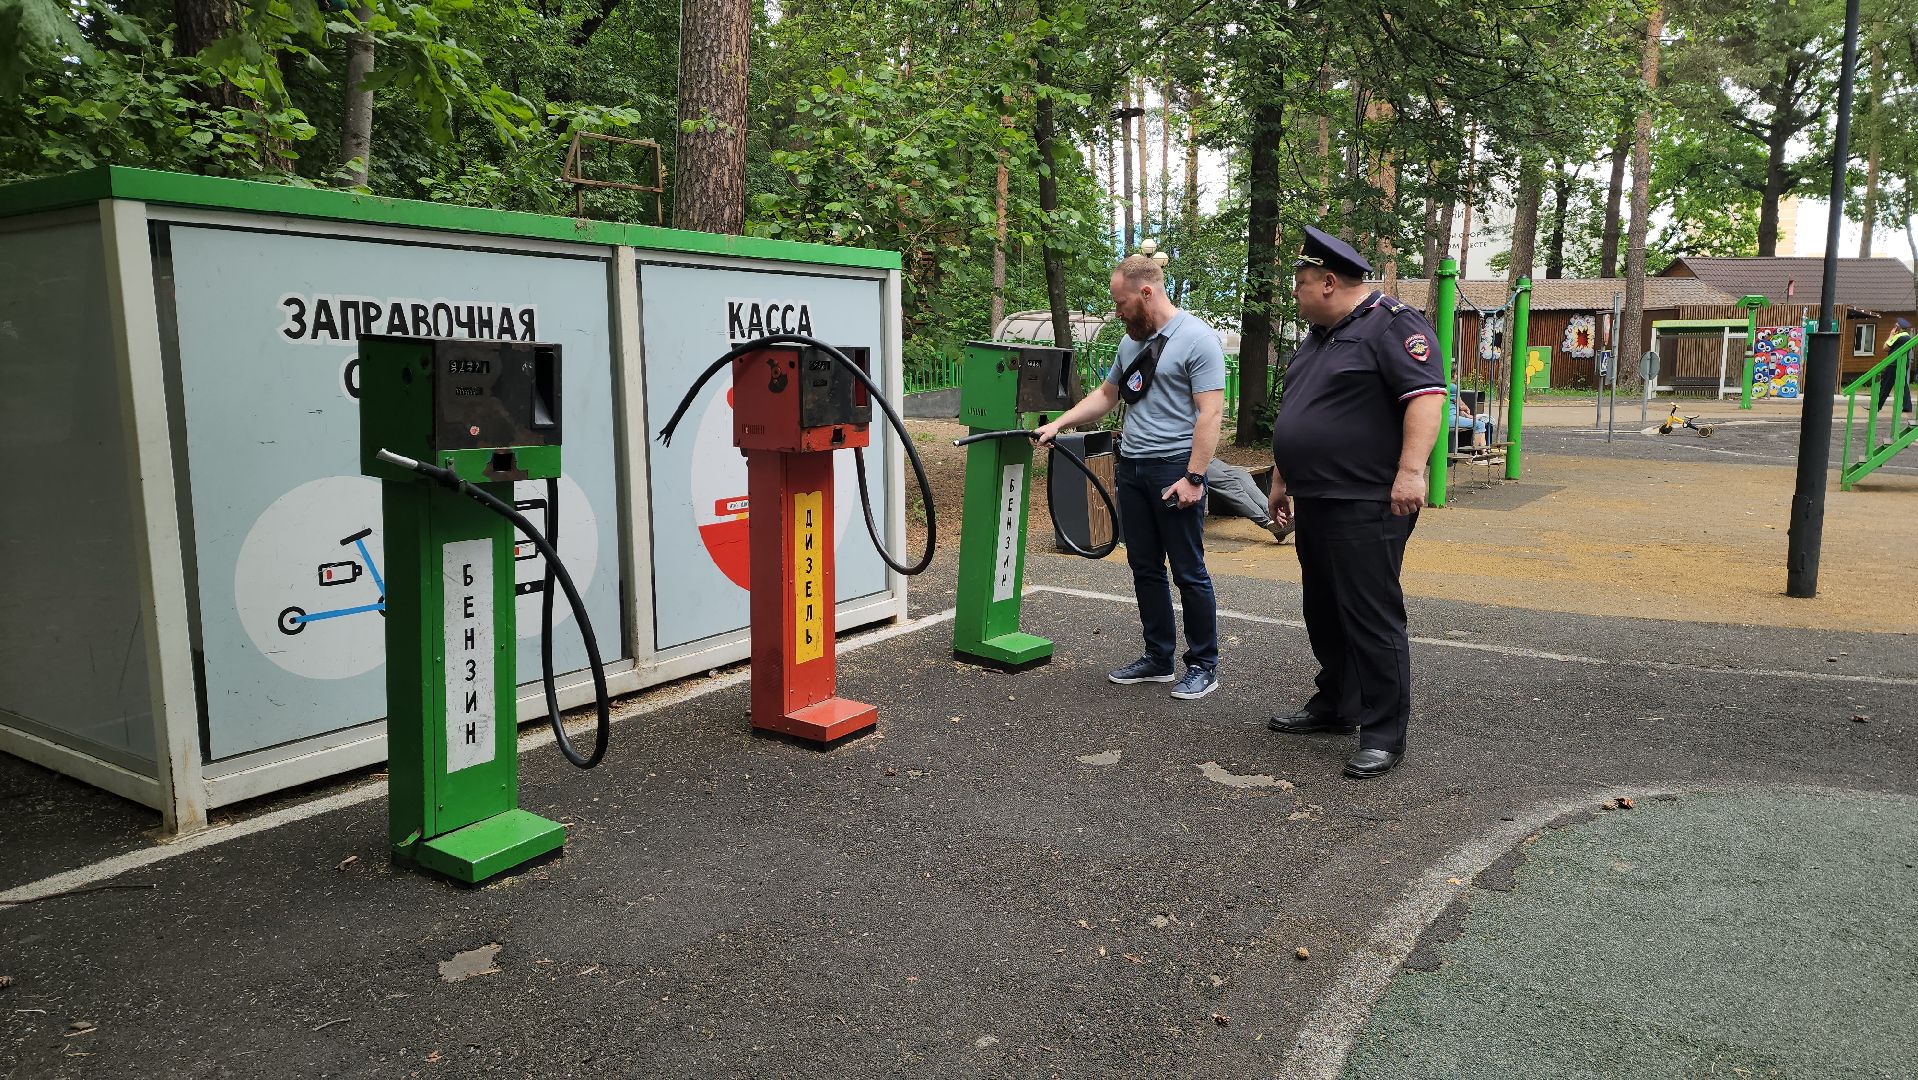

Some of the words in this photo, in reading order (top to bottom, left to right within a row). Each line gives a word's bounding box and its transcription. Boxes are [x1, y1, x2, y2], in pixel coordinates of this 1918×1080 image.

[282, 297, 536, 342] ЗАПРАВОЧНАЯ
[728, 302, 813, 340] КАССА
[804, 509, 813, 644] ДИЗЕЛЬ
[462, 563, 477, 745] БЕНЗИН
